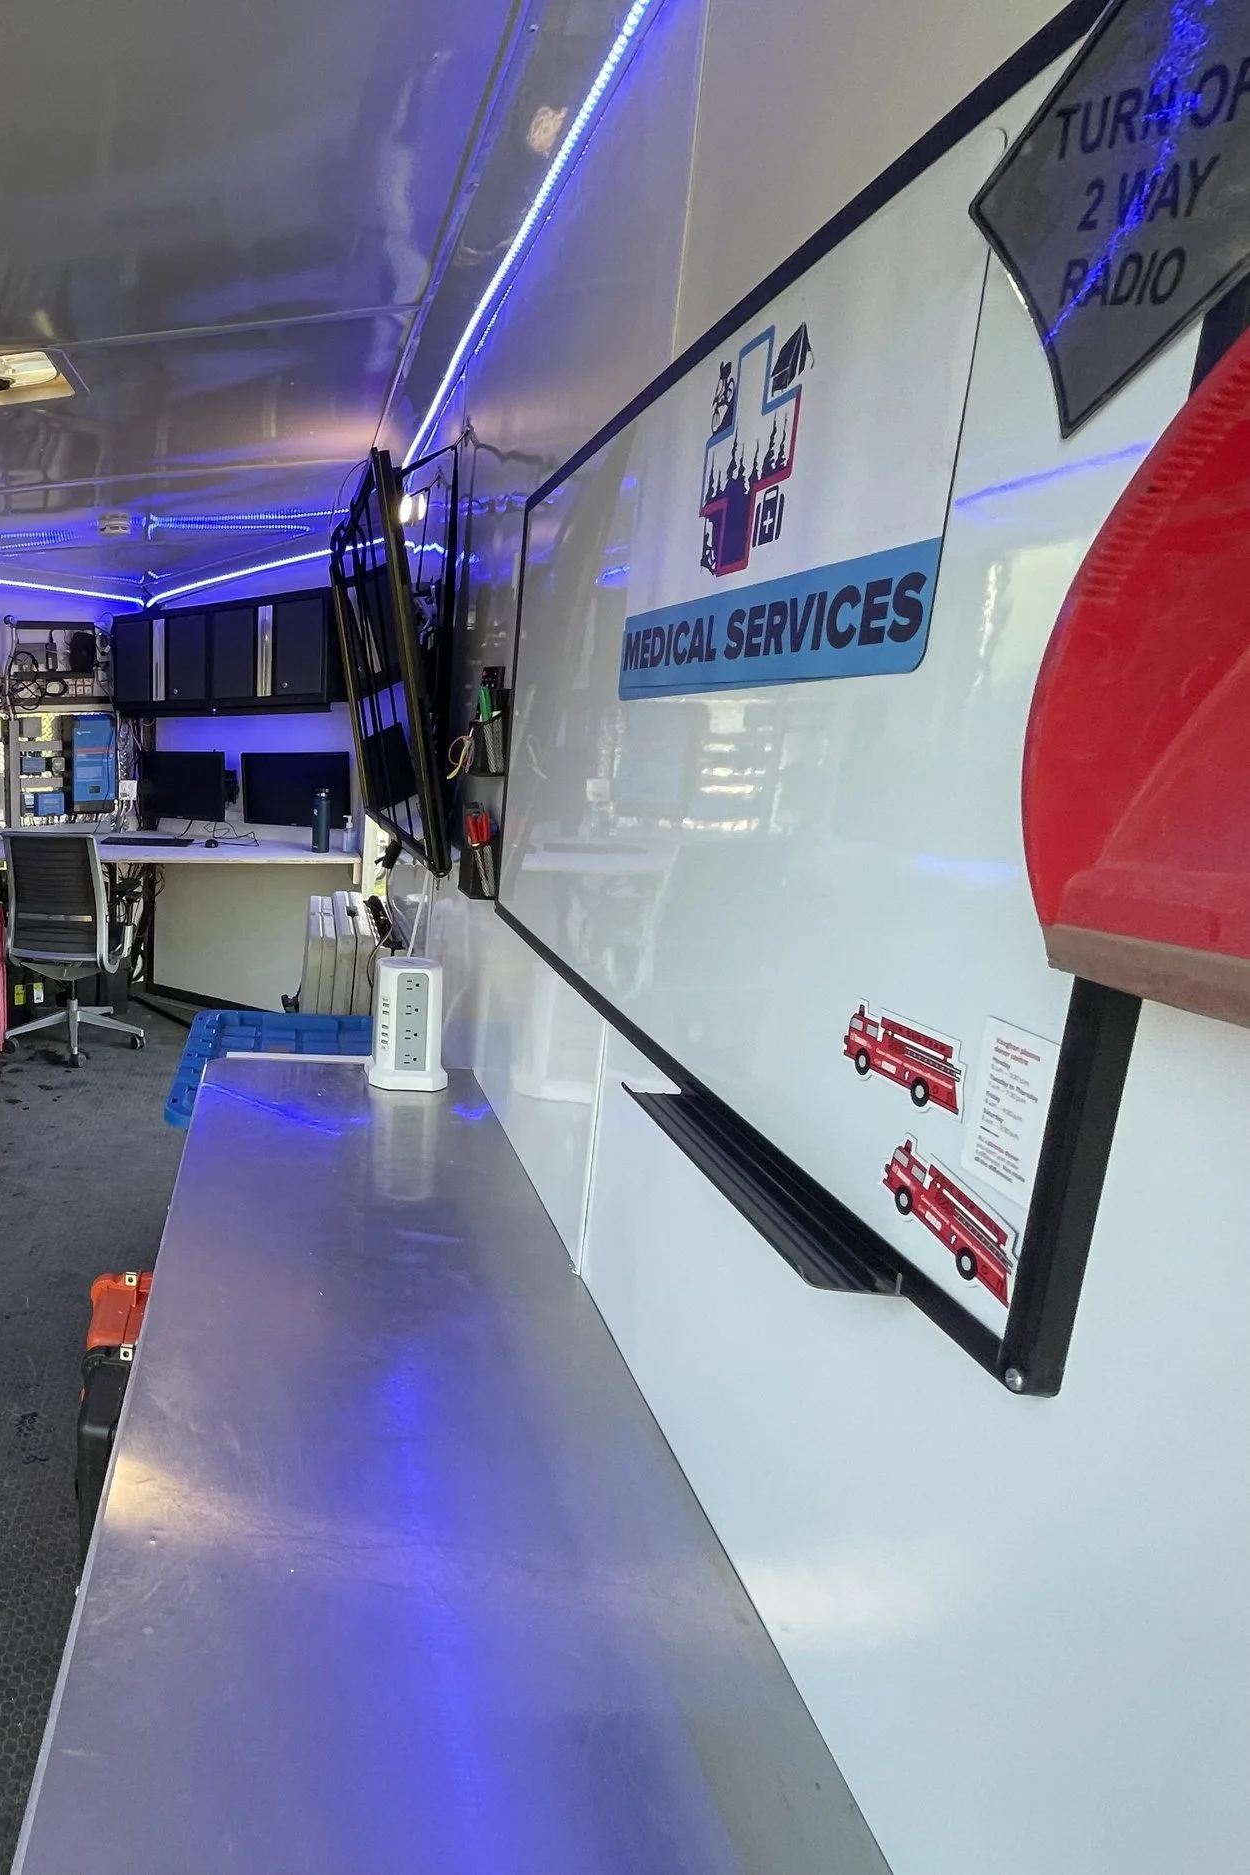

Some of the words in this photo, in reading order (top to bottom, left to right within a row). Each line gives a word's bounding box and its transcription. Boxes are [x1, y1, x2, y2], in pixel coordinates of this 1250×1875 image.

[1056, 76, 1180, 160] TURN
[1190, 56, 1250, 129] OF
[1077, 177, 1106, 232] 2
[1118, 154, 1220, 226] WAY
[1059, 247, 1186, 307] RADIO
[623, 615, 717, 671] MEDICAL
[724, 571, 928, 659] SERVICES
